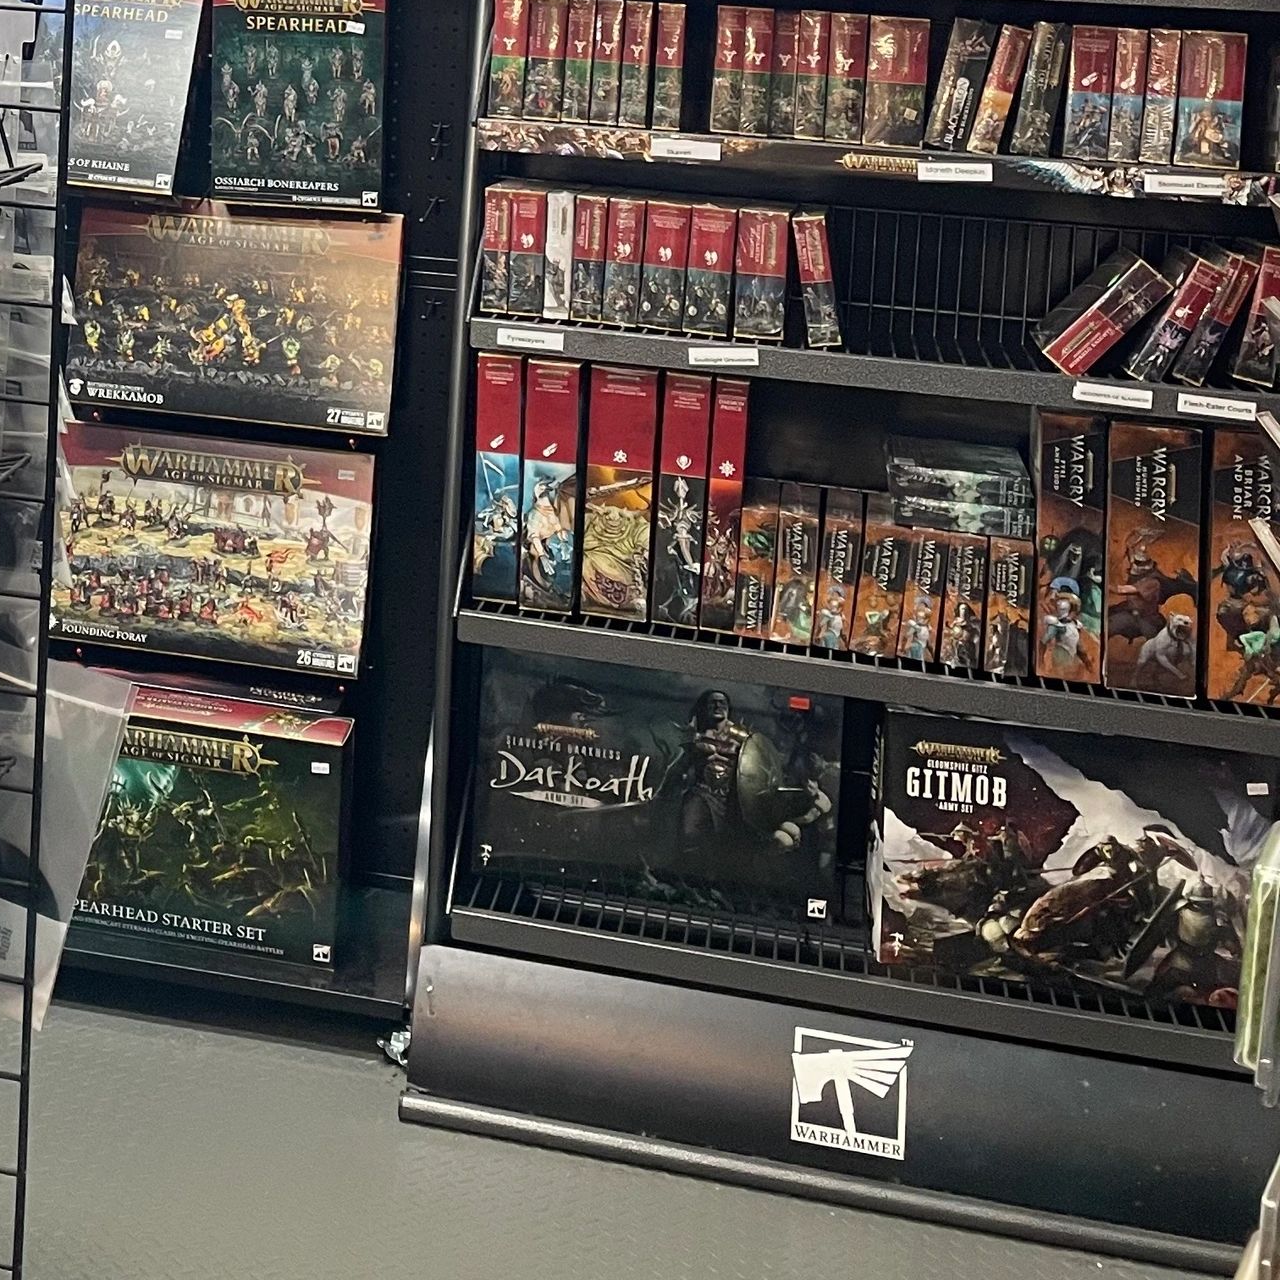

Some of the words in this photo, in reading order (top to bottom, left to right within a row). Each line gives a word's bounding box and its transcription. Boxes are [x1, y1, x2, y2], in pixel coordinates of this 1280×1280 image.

[74, 3, 169, 23] SPEARHEAD
[263, 3, 284, 12] AGE
[296, 4, 335, 14] SIGMAR
[246, 15, 349, 34] SPEARHEAD
[76, 158, 90, 168] OF
[91, 159, 130, 172] KHAINE
[214, 176, 265, 188] OSSIARCH
[267, 179, 340, 192] BONEREAPERS
[148, 214, 330, 256] WARHAMMER
[188, 236, 217, 245] AGE
[218, 238, 233, 246] OF
[234, 240, 290, 253] SIGMAR
[86, 387, 164, 405] WREKKAMOB
[1183, 400, 1225, 411] Flesh-Eater
[1227, 404, 1252, 414] Courts
[326, 408, 341, 423] 27
[124, 444, 303, 497] WARHAMMER
[163, 470, 189, 480] AGE
[192, 473, 206, 481] OF
[207, 475, 263, 490] SIGMAR
[1070, 434, 1085, 508] WARCRY
[1233, 453, 1244, 482] AND
[1151, 447, 1167, 522] WARCRY
[1243, 469, 1253, 508] BRIAR
[1232, 486, 1243, 521] BONE
[791, 522, 803, 576] WARCRY
[833, 530, 848, 584] WARCRY
[877, 537, 894, 591] WARCRY
[920, 540, 936, 595] WARCRY
[1007, 552, 1020, 608] WARCRY
[746, 576, 760, 629] WARCRY
[61, 622, 115, 641] FOUNDING
[115, 630, 148, 644] FORAY
[296, 649, 312, 665] 26
[122, 728, 260, 776] ARHAMMER
[122, 746, 148, 758] AGE
[167, 752, 221, 768] SIGMAR
[506, 734, 543, 751] SLAVES
[549, 741, 561, 753] TO
[567, 743, 621, 761] DARKNESS
[489, 750, 653, 804] Darkoath
[926, 758, 969, 773] GLOOMSPITE
[971, 763, 988, 775] GITZ
[544, 791, 567, 803] ARMY
[906, 766, 1007, 809] GITMOB
[938, 801, 958, 812] ARMY
[960, 803, 974, 814] SET
[72, 899, 158, 924] PEARHEAD
[162, 913, 233, 936] STARTER
[236, 925, 267, 941] SET
[794, 1124, 901, 1157] WARHAMMER
